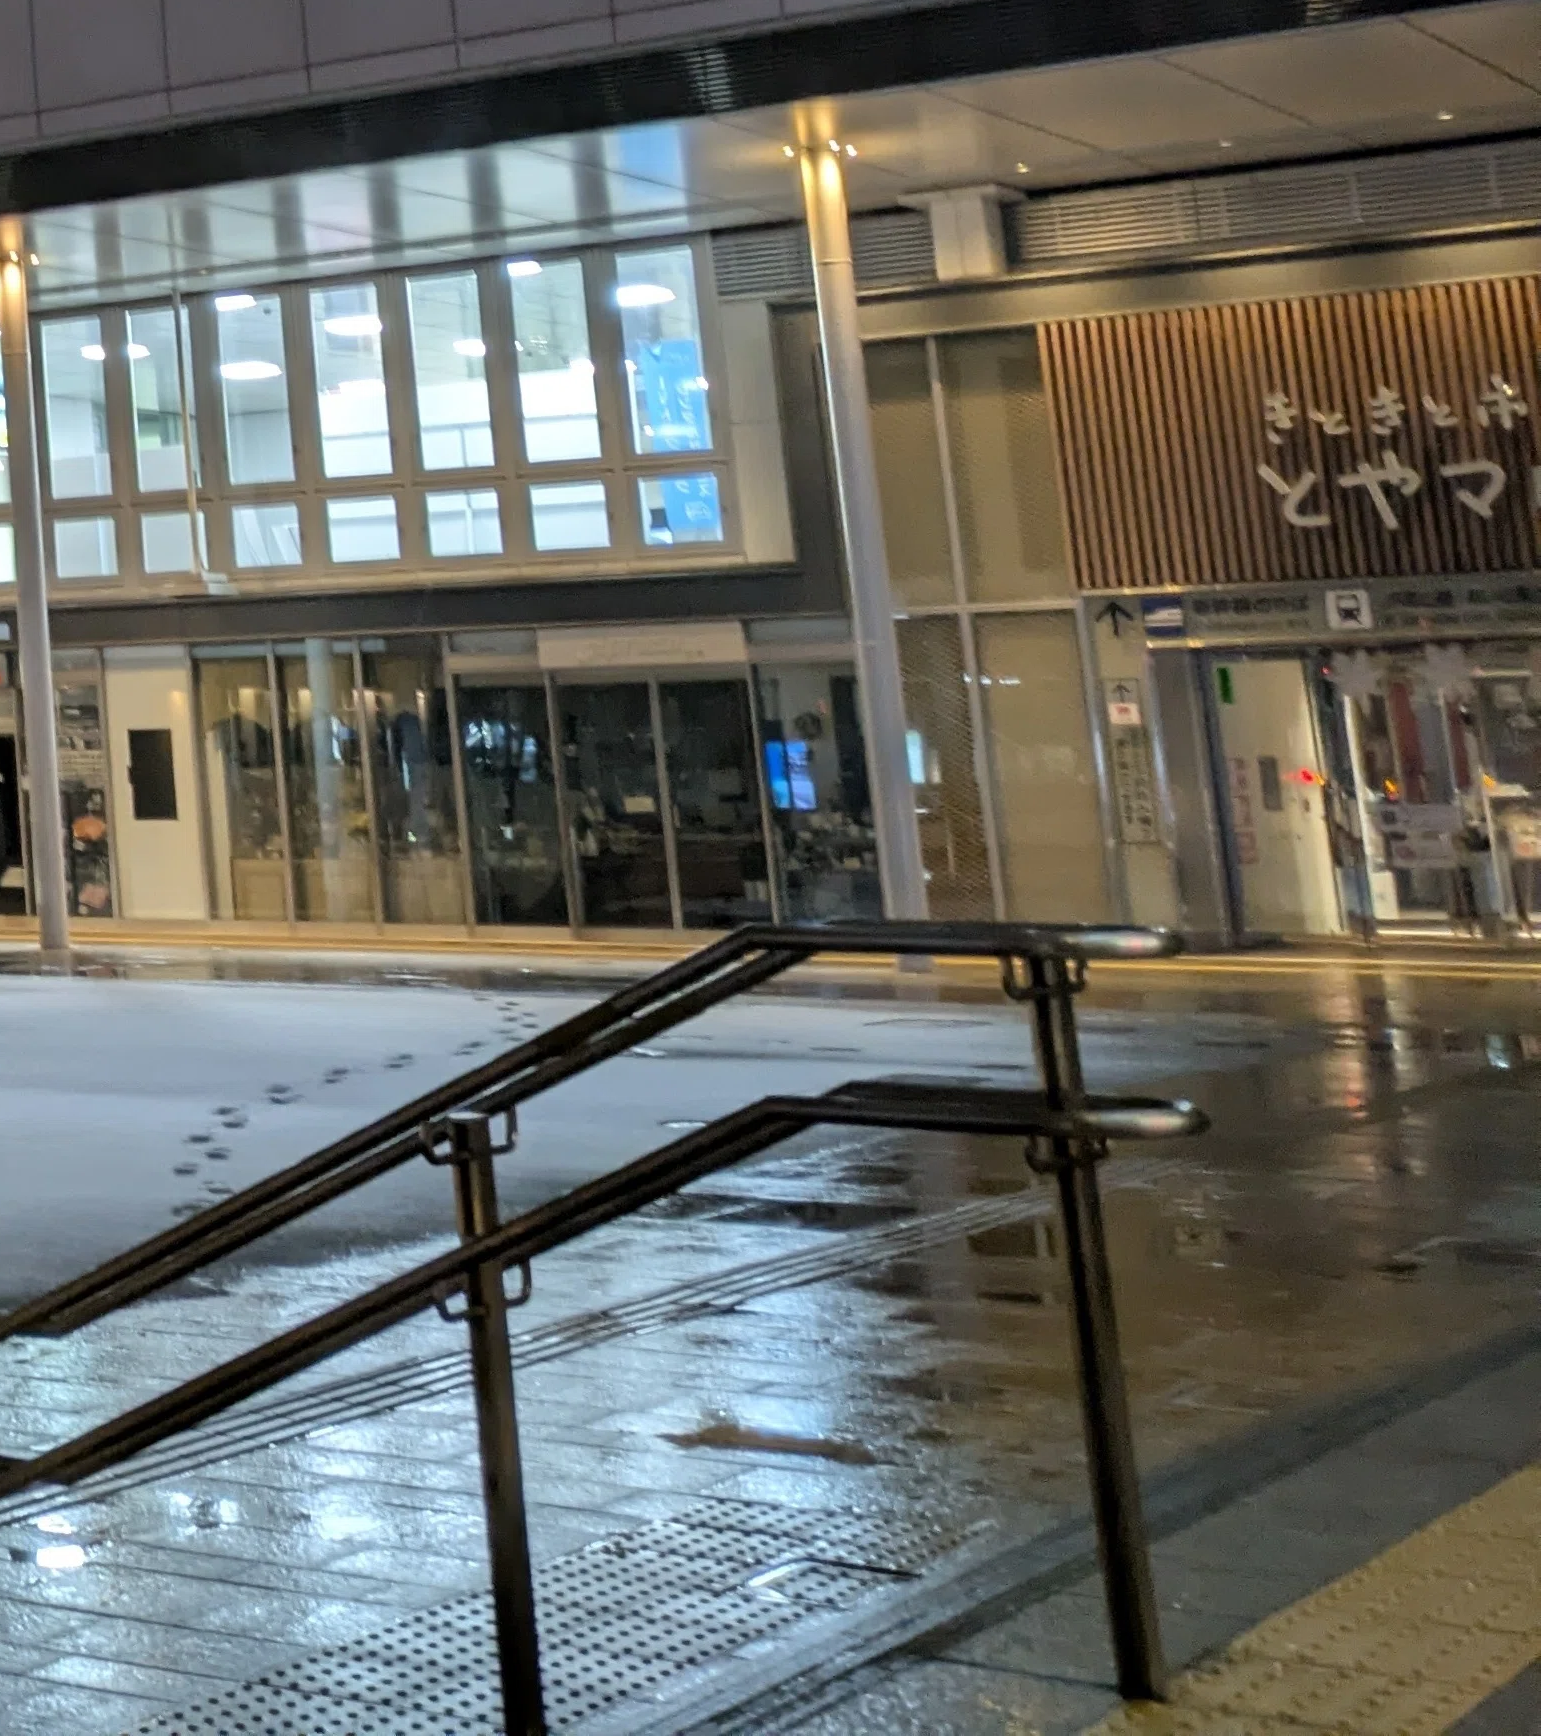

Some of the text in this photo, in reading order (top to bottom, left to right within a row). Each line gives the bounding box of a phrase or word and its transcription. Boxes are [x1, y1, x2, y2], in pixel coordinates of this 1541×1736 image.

[1263, 374, 1528, 444] きときと市
[1258, 450, 1541, 530] とやマ
